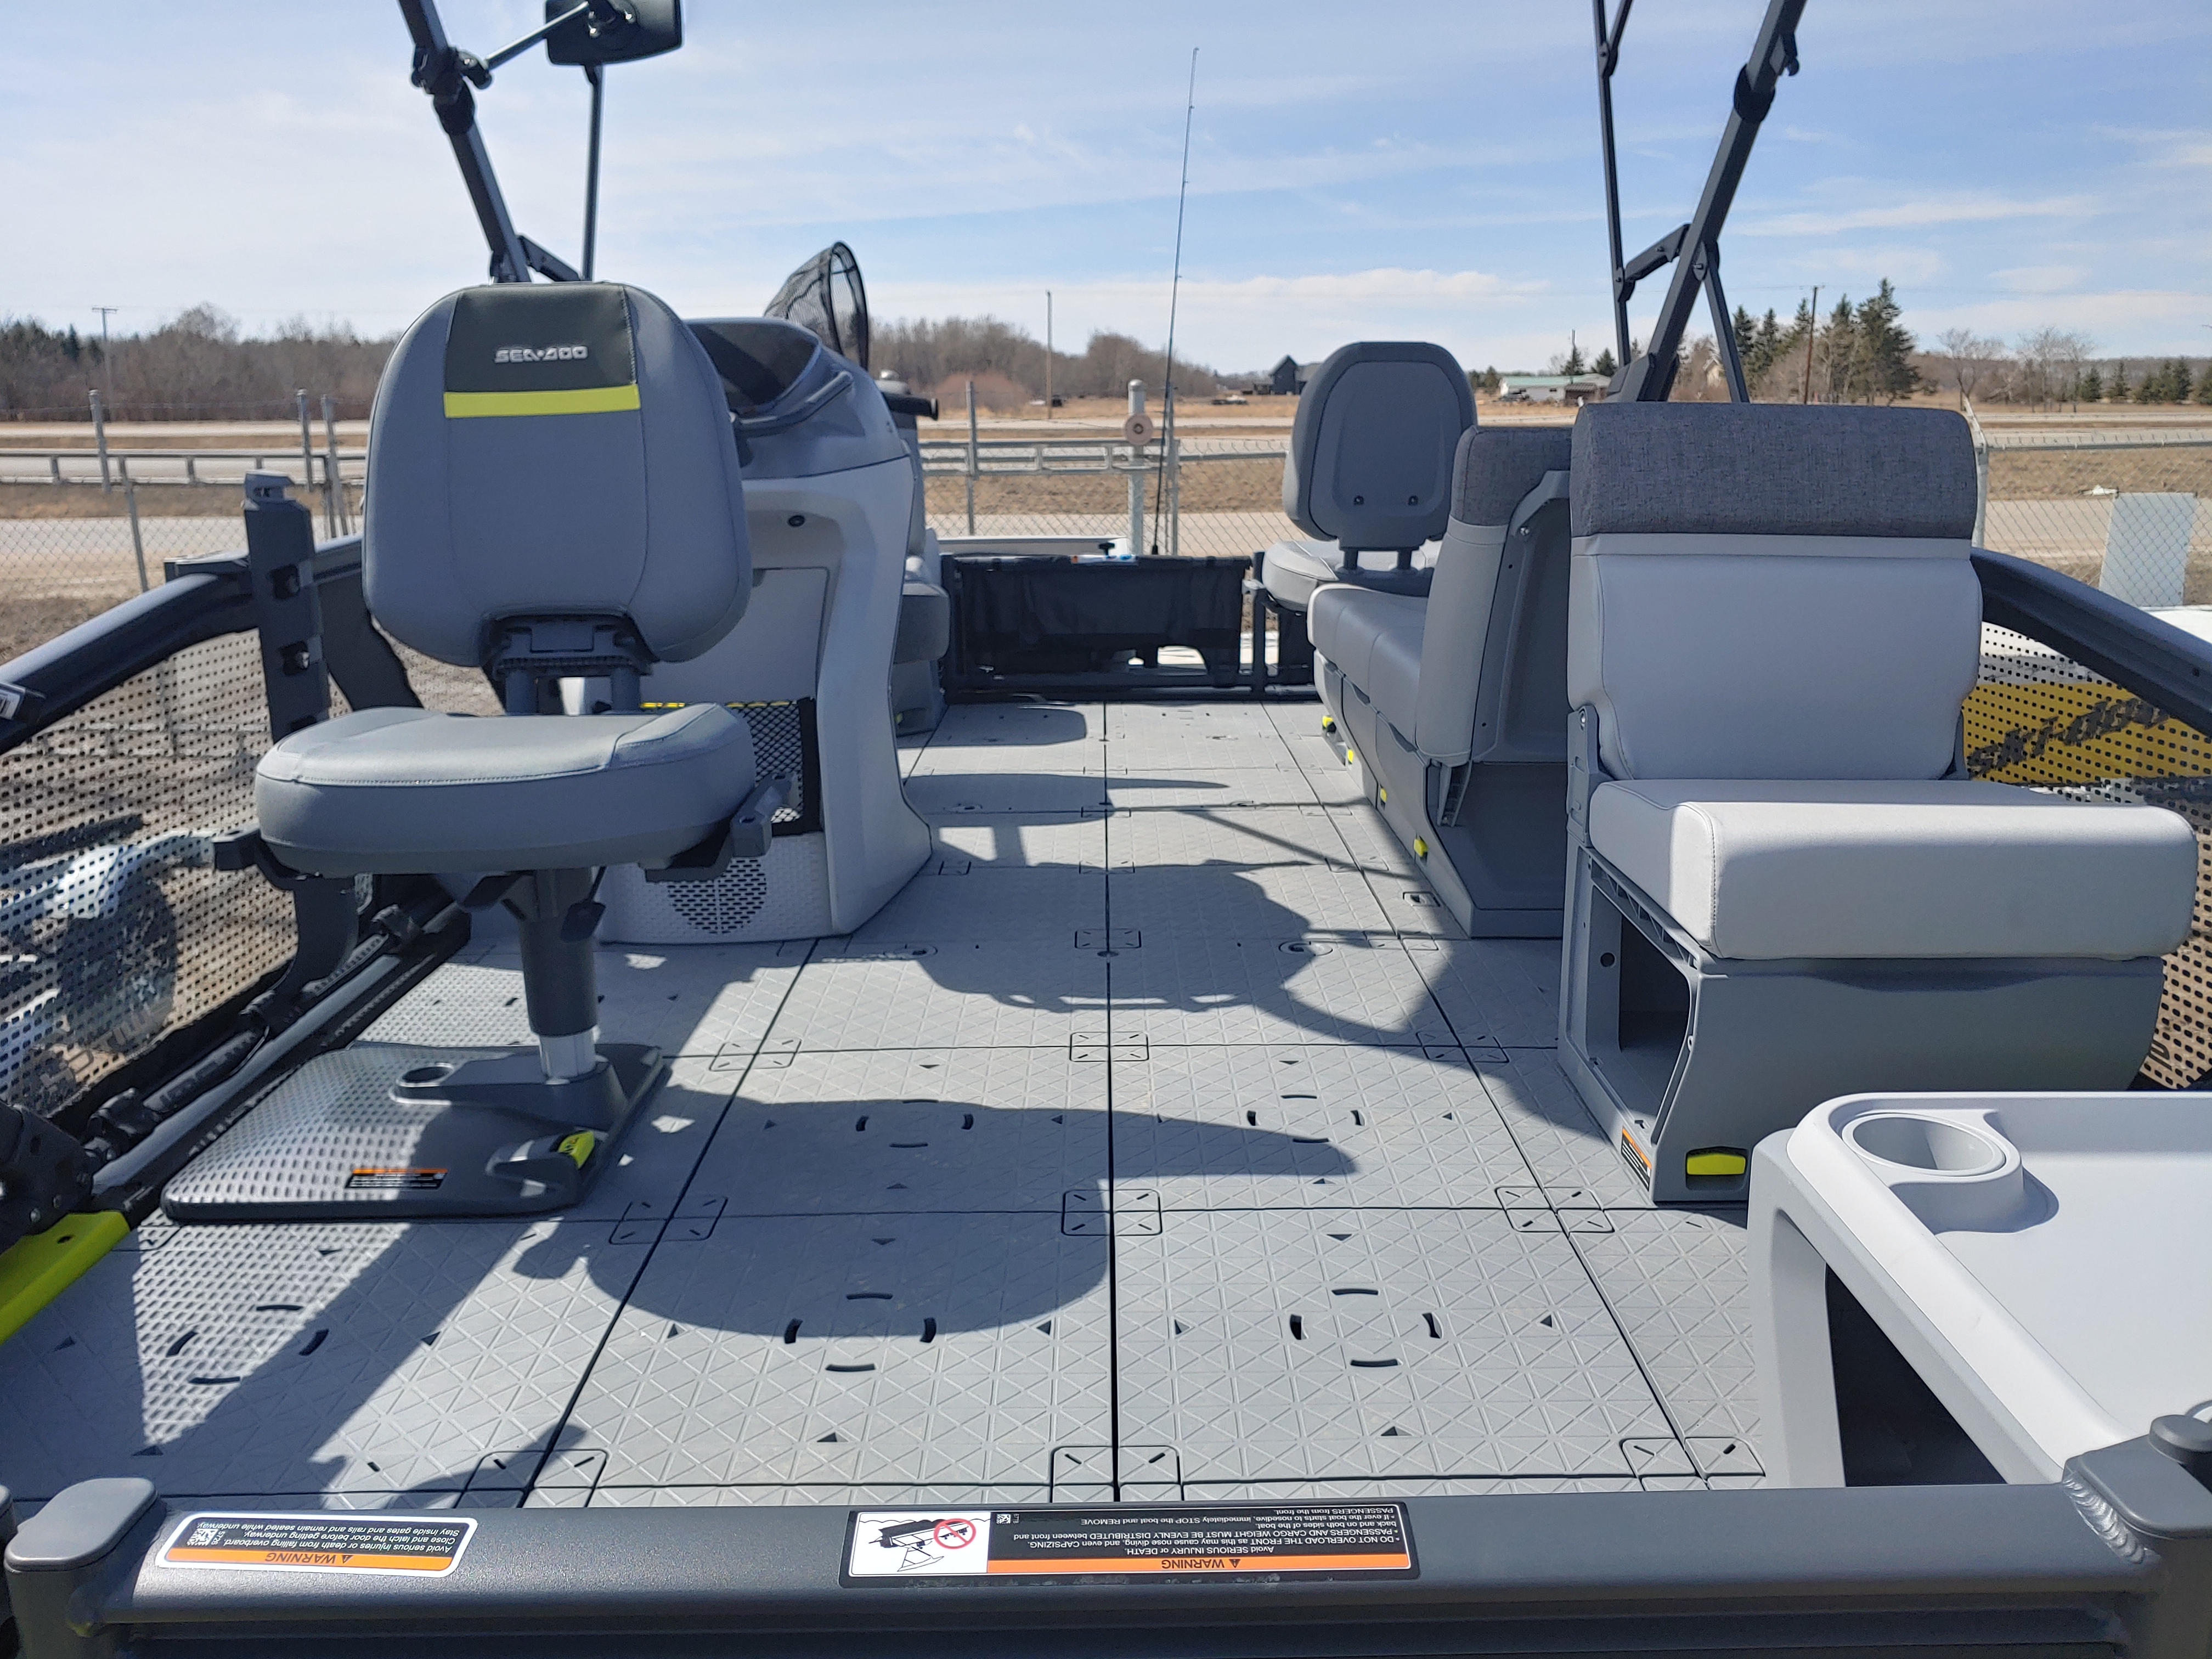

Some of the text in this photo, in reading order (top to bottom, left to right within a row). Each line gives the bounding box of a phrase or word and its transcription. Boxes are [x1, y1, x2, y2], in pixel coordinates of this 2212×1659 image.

[244, 1531, 287, 1539] underway.
[289, 1532, 319, 1540] getting
[270, 1539, 297, 1548] falling
[360, 1543, 392, 1551] injuries
[264, 1553, 336, 1564] WARNING
[1161, 1559, 1224, 1569] WARNING
